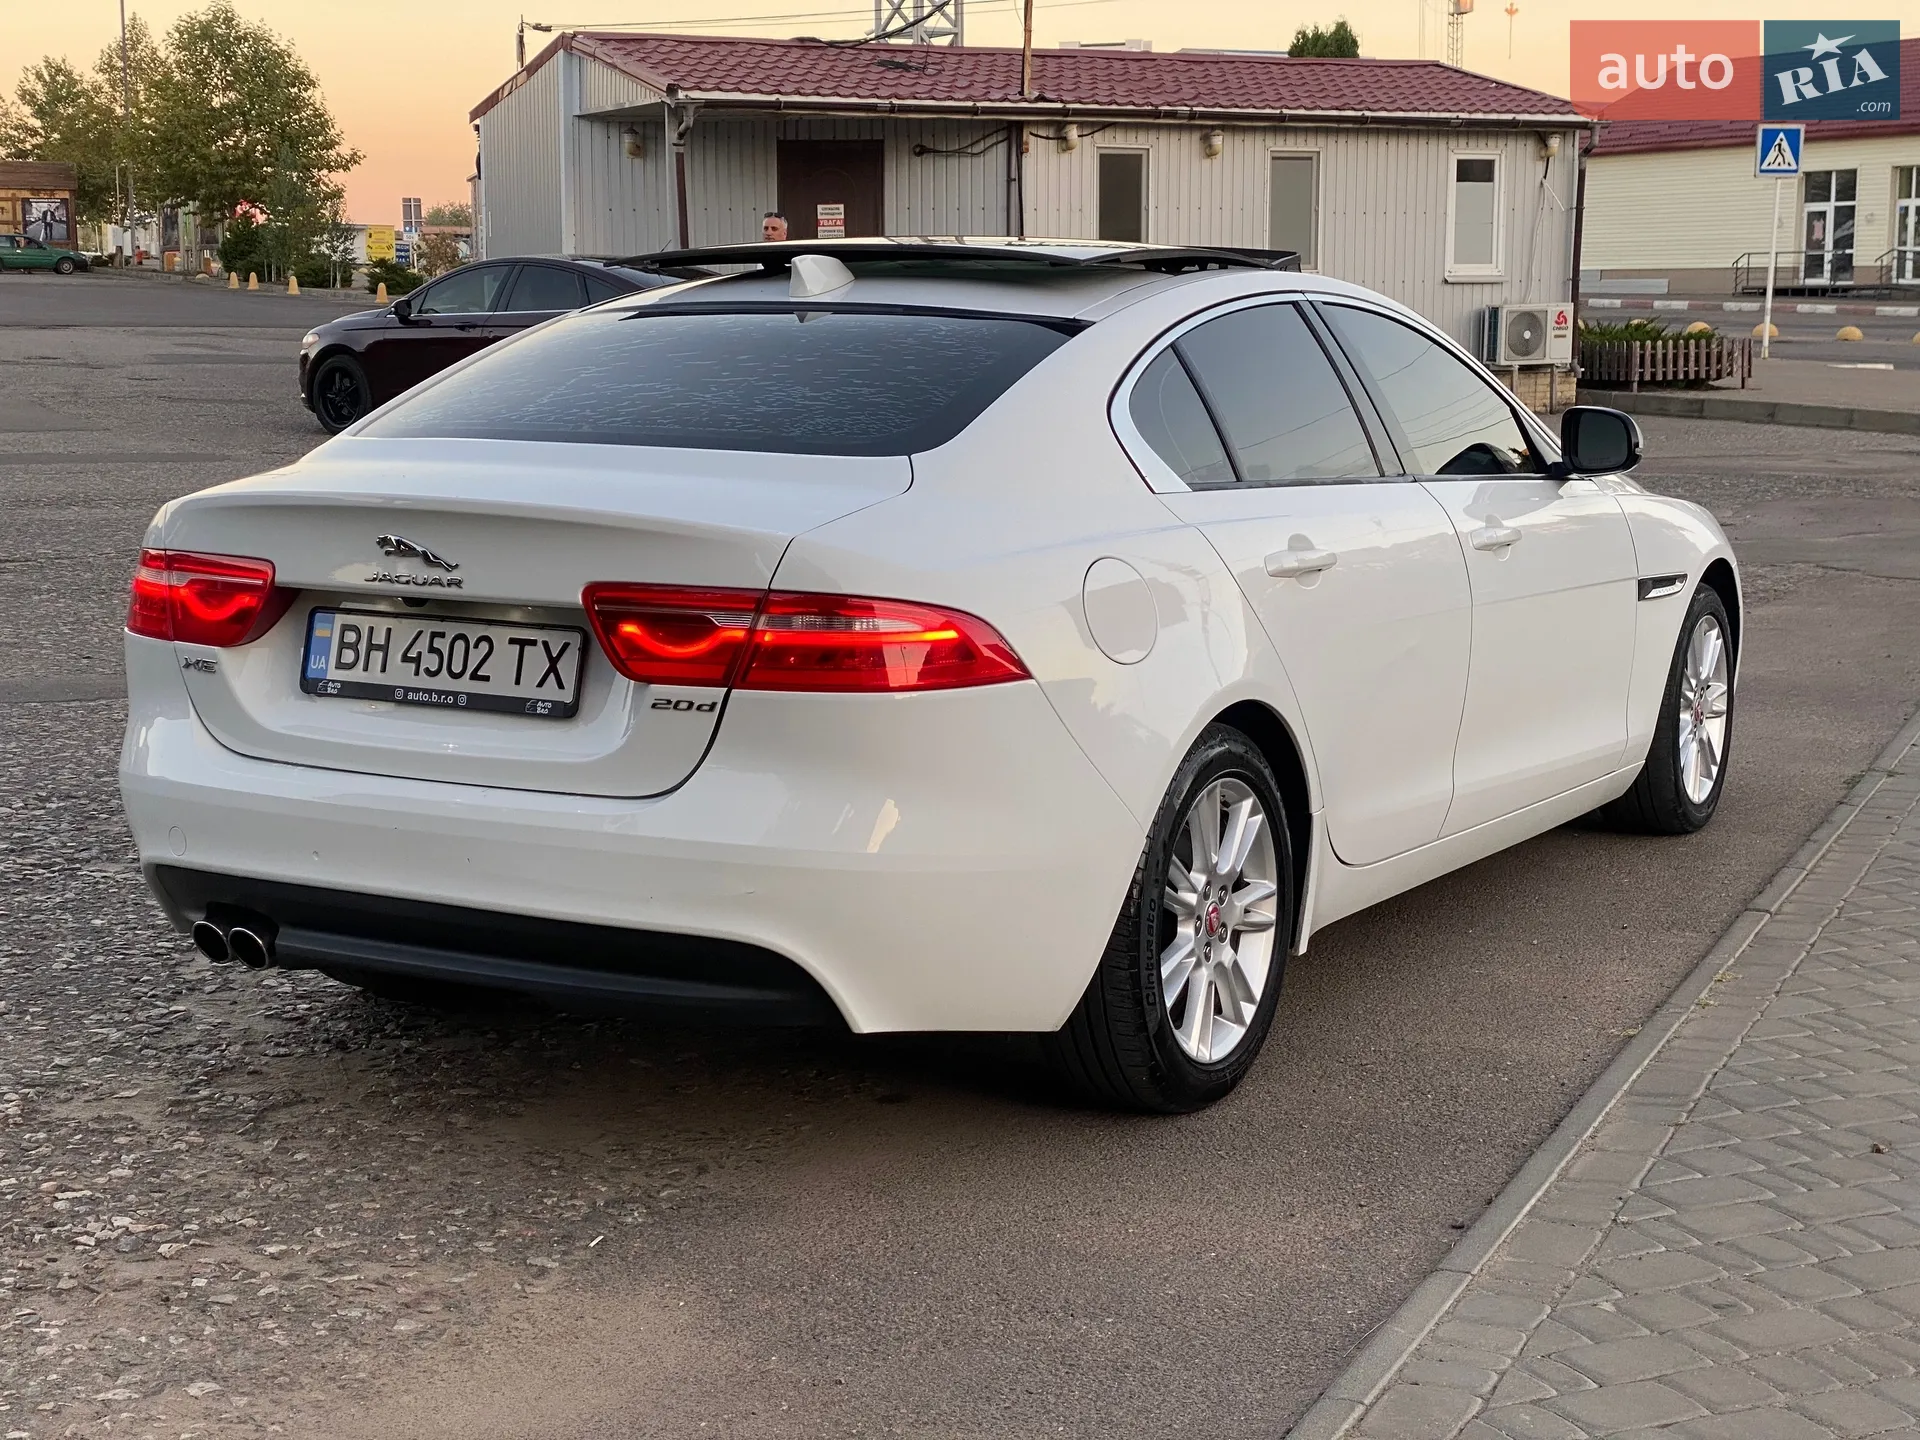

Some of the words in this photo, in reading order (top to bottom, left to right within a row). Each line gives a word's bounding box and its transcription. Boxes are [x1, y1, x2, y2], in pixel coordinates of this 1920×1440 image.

[364, 571, 463, 589] JAGUAR
[182, 655, 218, 674] XE
[310, 654, 327, 671] UA
[334, 623, 392, 673] BH
[401, 629, 495, 683] 4502
[508, 636, 571, 691] TX
[407, 691, 454, 704] auto.b.r.o
[650, 698, 718, 712] 20d
